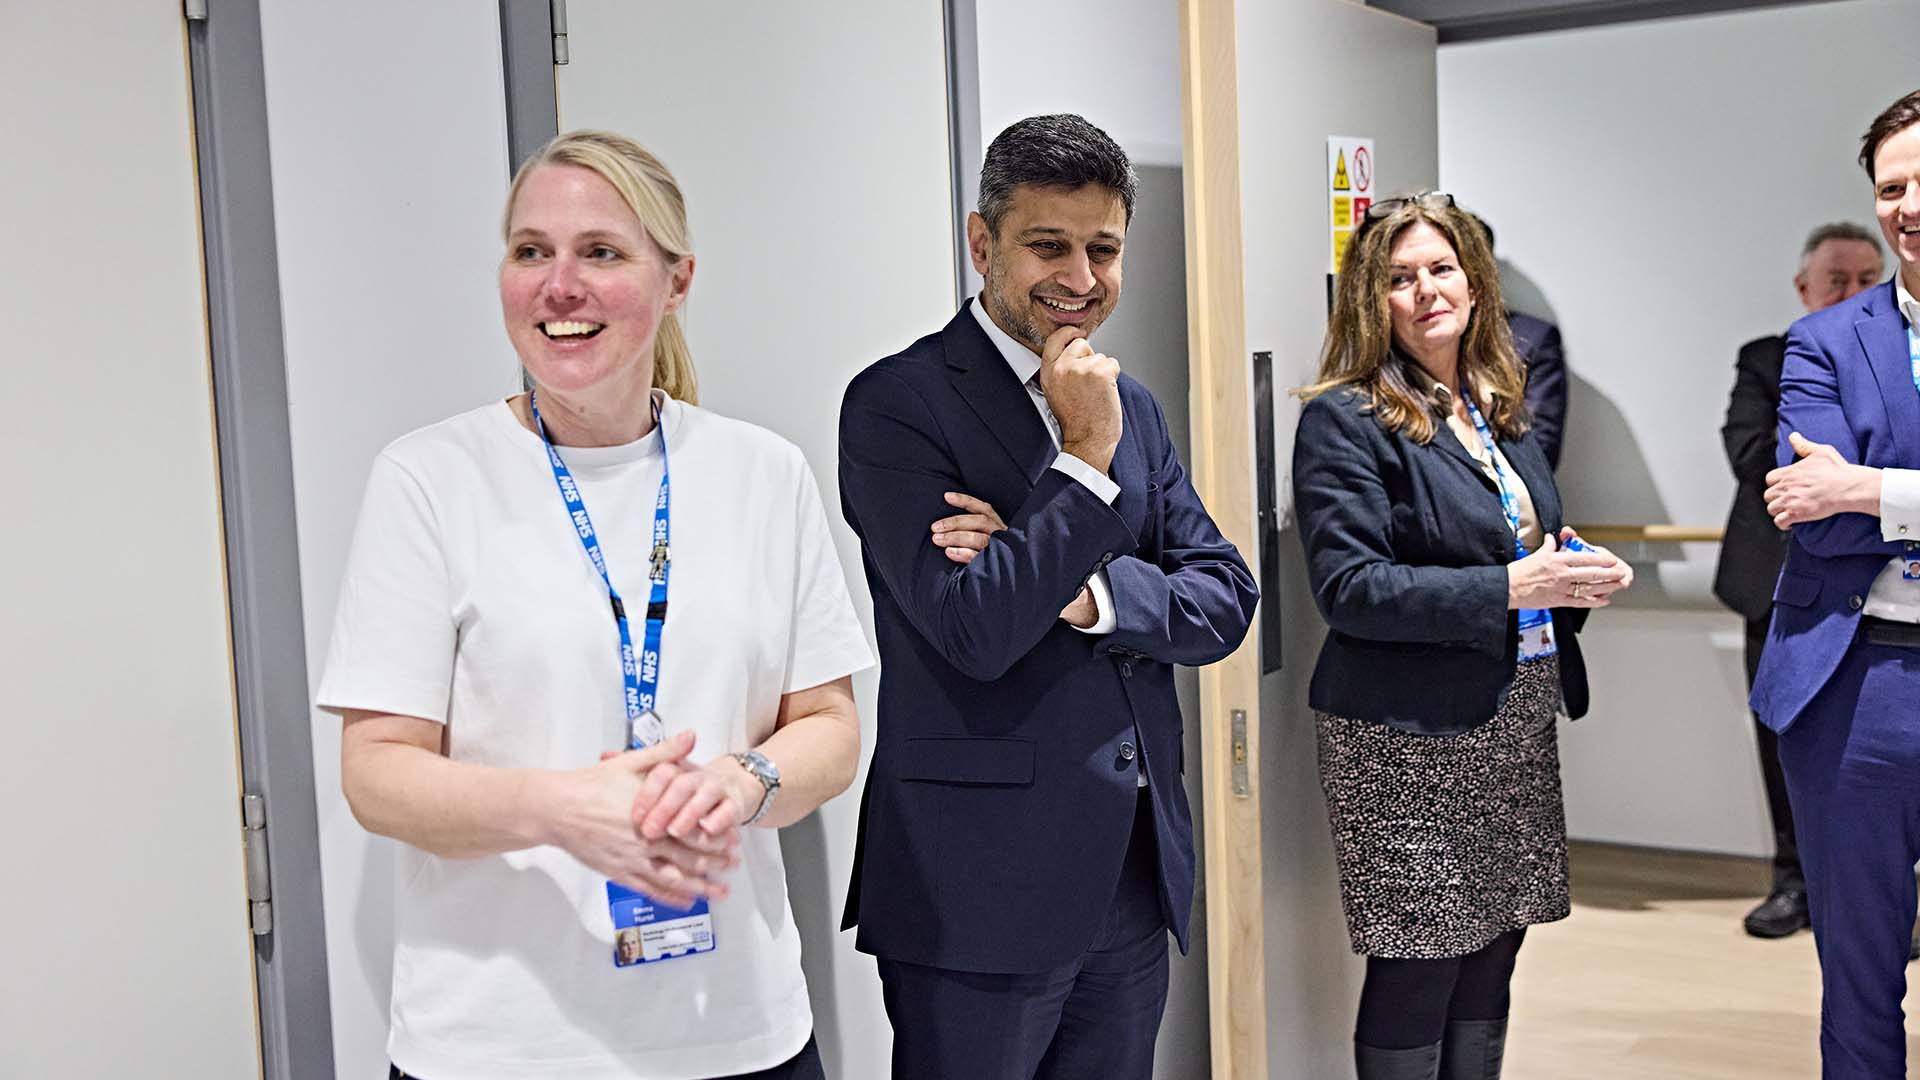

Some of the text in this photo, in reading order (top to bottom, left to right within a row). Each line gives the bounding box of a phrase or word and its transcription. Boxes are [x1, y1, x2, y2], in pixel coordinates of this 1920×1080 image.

[558, 475, 579, 503] NHS
[571, 509, 593, 539] NHS
[622, 643, 636, 677] NHS
[642, 650, 658, 684] NHS
